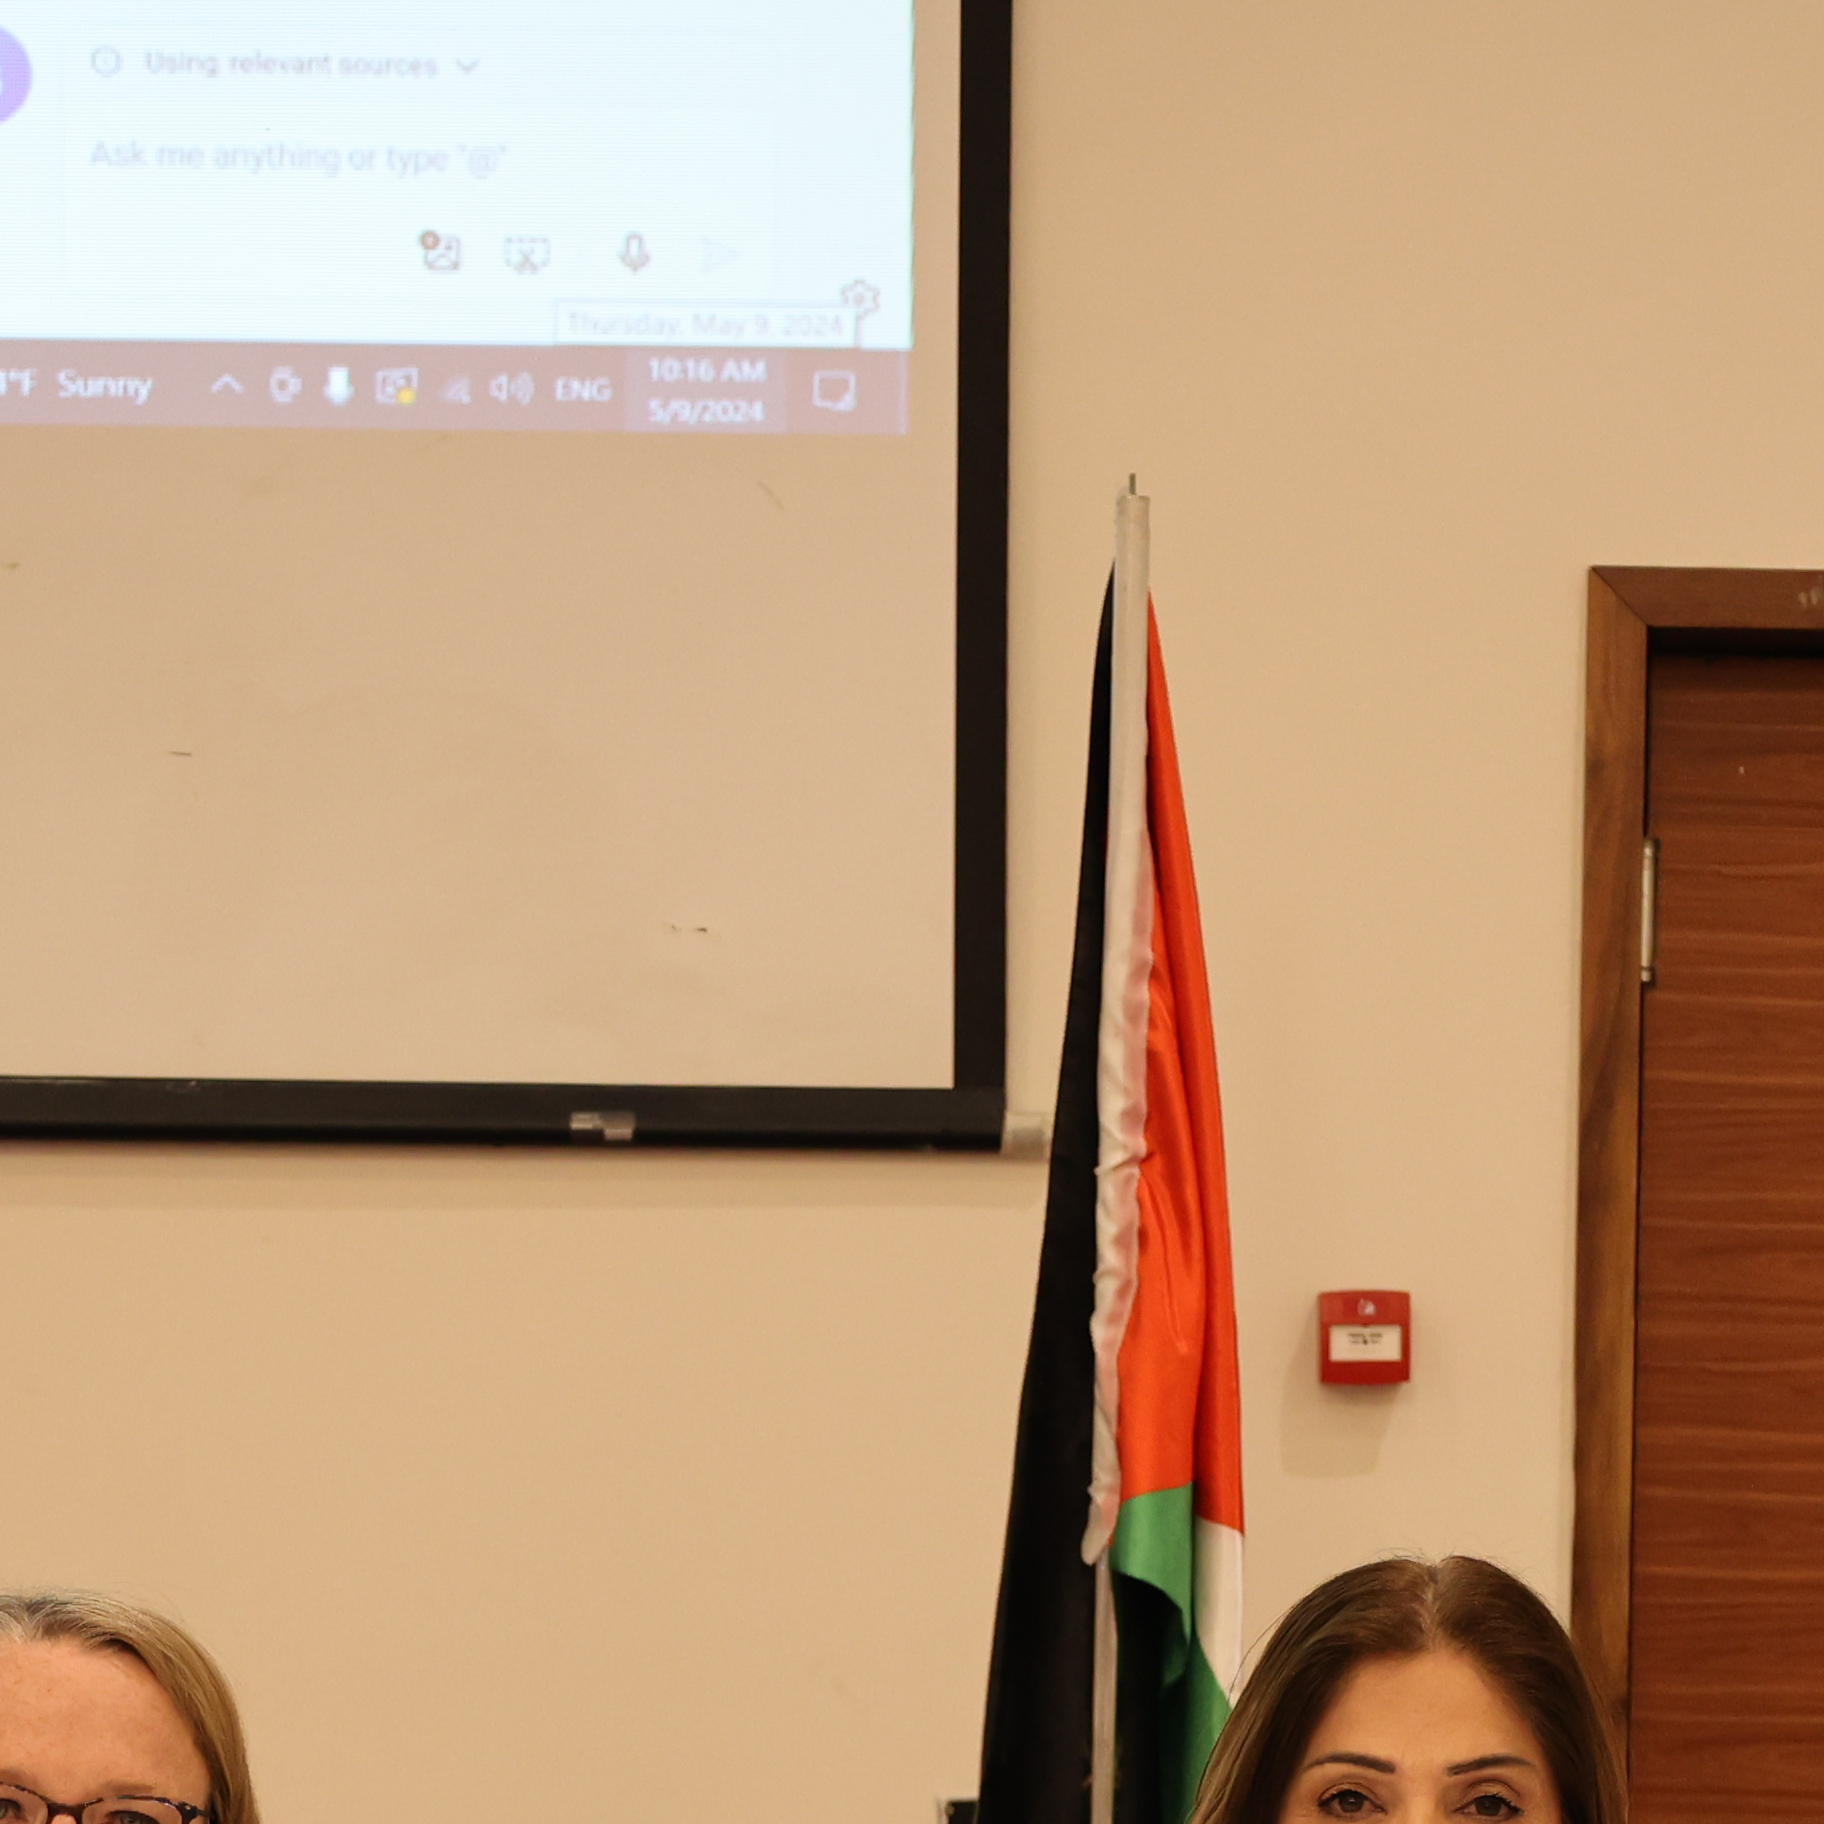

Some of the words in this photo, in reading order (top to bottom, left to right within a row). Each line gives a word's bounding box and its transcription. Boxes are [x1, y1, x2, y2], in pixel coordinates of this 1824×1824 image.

[146, 50, 220, 78] Using
[229, 51, 333, 74] relevant
[339, 56, 438, 77] sources
[90, 140, 146, 168] Ask
[156, 146, 204, 168] me
[212, 142, 341, 176] anything
[347, 147, 377, 169] or
[386, 146, 450, 176] type
[691, 313, 746, 339] May
[781, 315, 844, 338] 2024
[648, 357, 716, 382] 10:16
[720, 358, 768, 382] AM
[58, 369, 153, 406] Sunny
[555, 376, 612, 402] ENG
[648, 400, 765, 425] 5/9/2024
